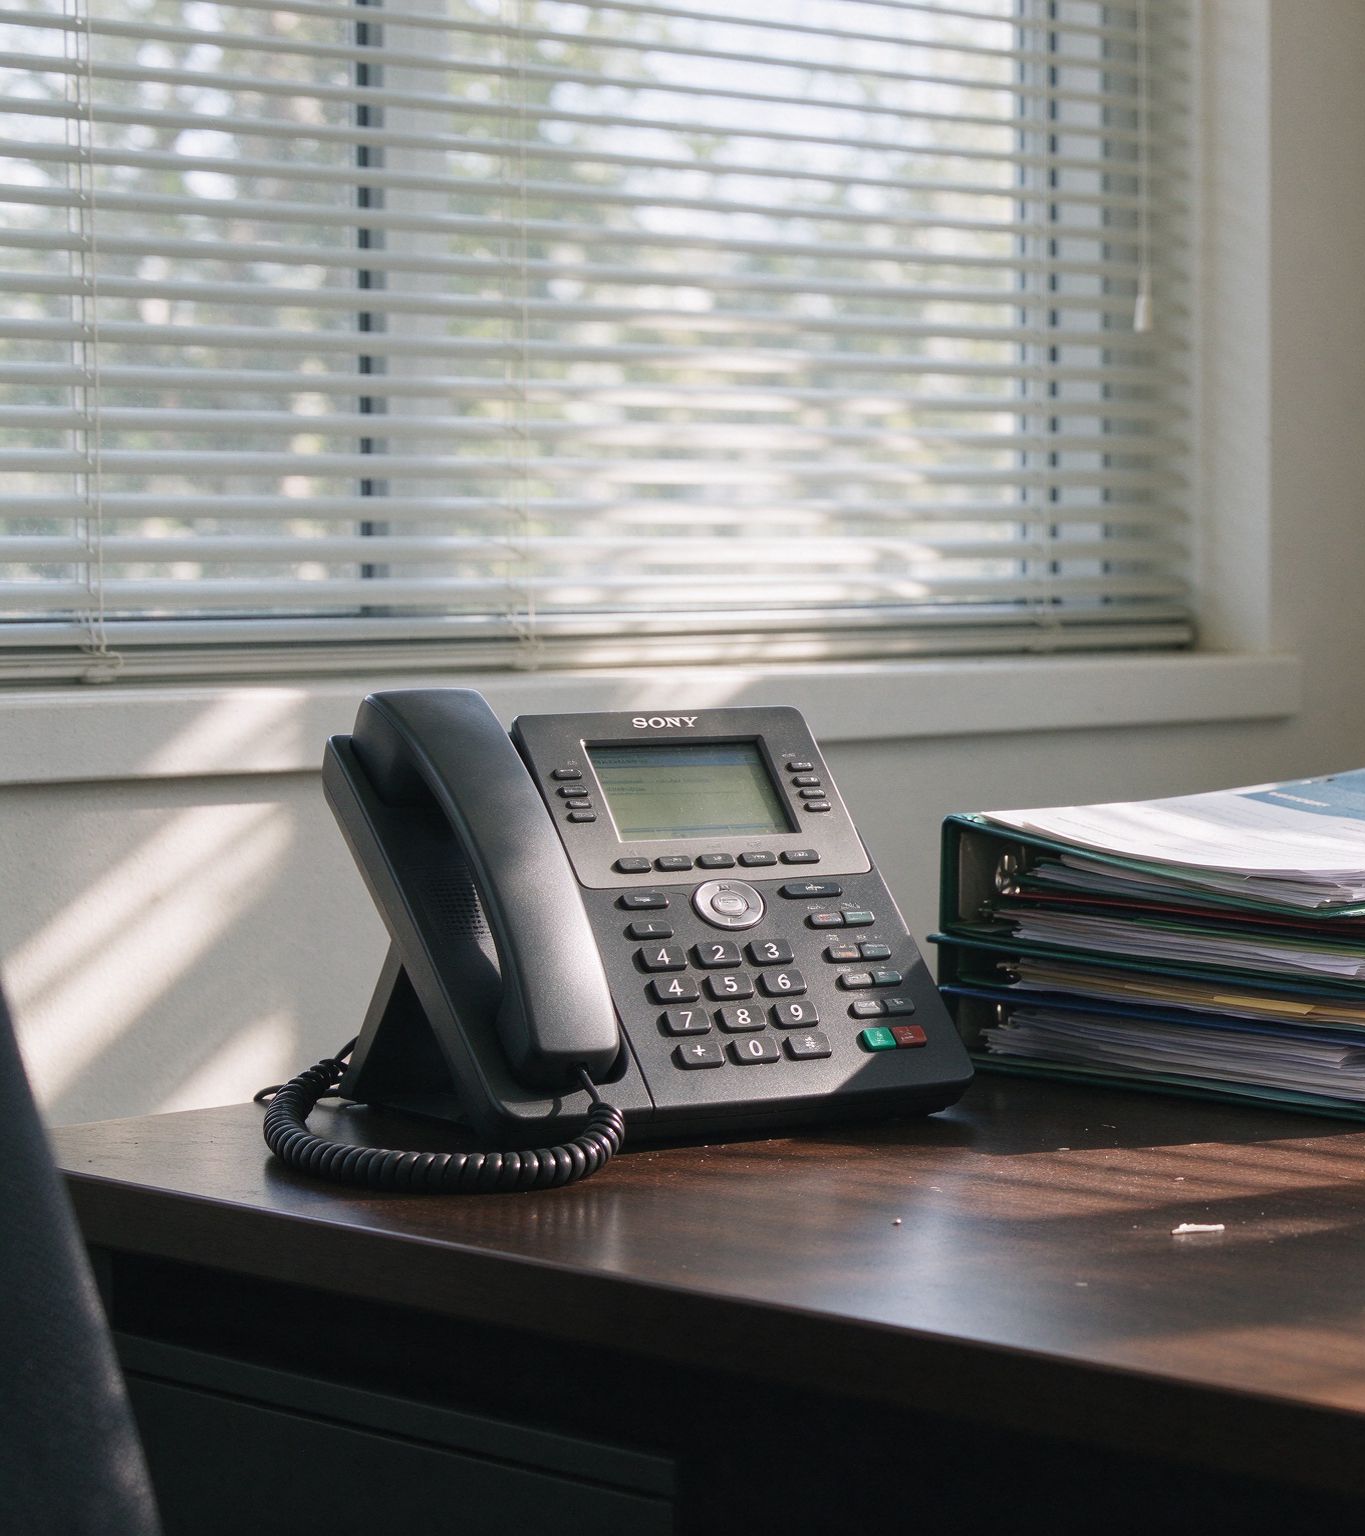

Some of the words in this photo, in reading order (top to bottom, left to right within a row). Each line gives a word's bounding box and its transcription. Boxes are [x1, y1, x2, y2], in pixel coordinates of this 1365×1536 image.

[632, 716, 698, 729] SONY
[656, 948, 671, 965] 4
[711, 945, 725, 960] 2
[764, 942, 780, 959] 3
[668, 978, 684, 996] 4
[723, 976, 738, 992] 5
[777, 973, 791, 990] 6
[679, 1011, 693, 1028] 7
[736, 1008, 751, 1025] 8
[790, 1004, 803, 1021] 9
[749, 1039, 764, 1057] 0
